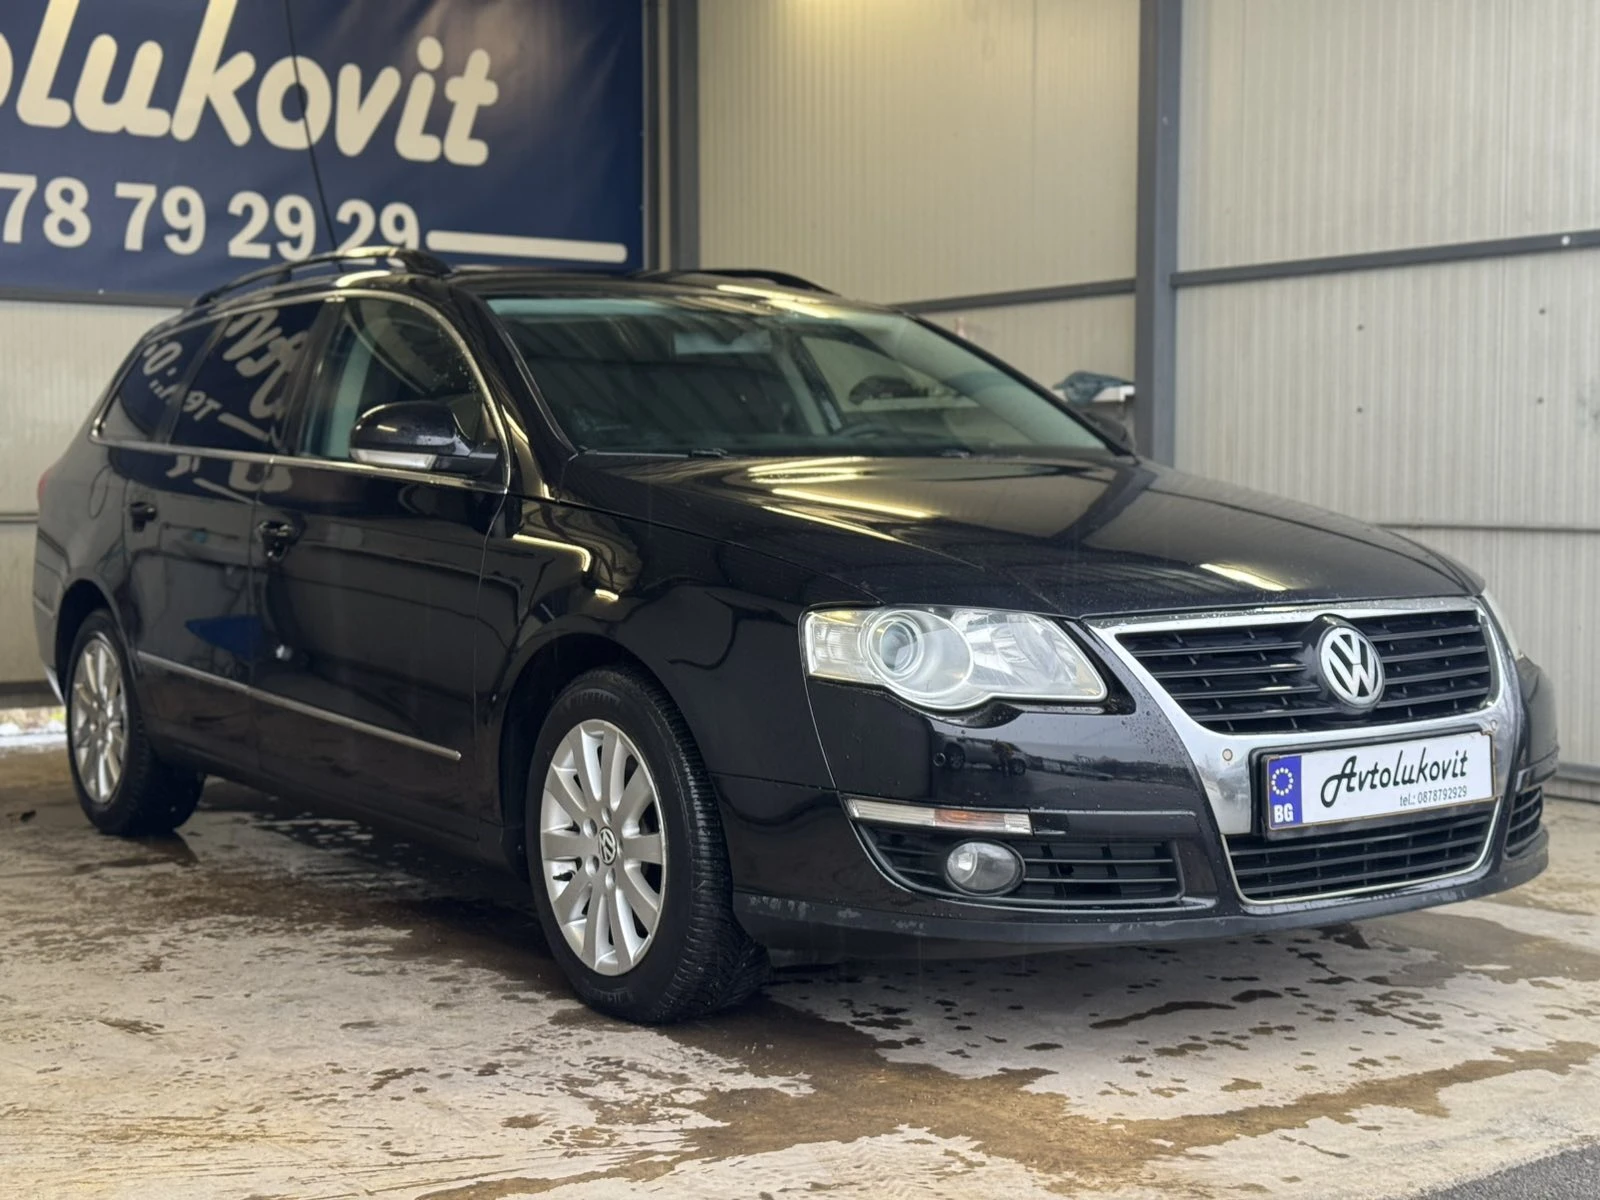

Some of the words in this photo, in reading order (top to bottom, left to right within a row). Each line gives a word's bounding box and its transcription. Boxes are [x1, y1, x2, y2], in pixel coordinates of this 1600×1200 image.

[0, 0, 498, 166] lukovit
[0, 172, 92, 248] 78
[115, 182, 206, 255] 79
[228, 191, 316, 261] 29
[336, 198, 419, 267] 29
[1320, 746, 1468, 808] Avtolukovit
[1400, 792, 1416, 807] tel.:
[1417, 785, 1467, 804] 0878792929
[1274, 802, 1294, 823] BG
